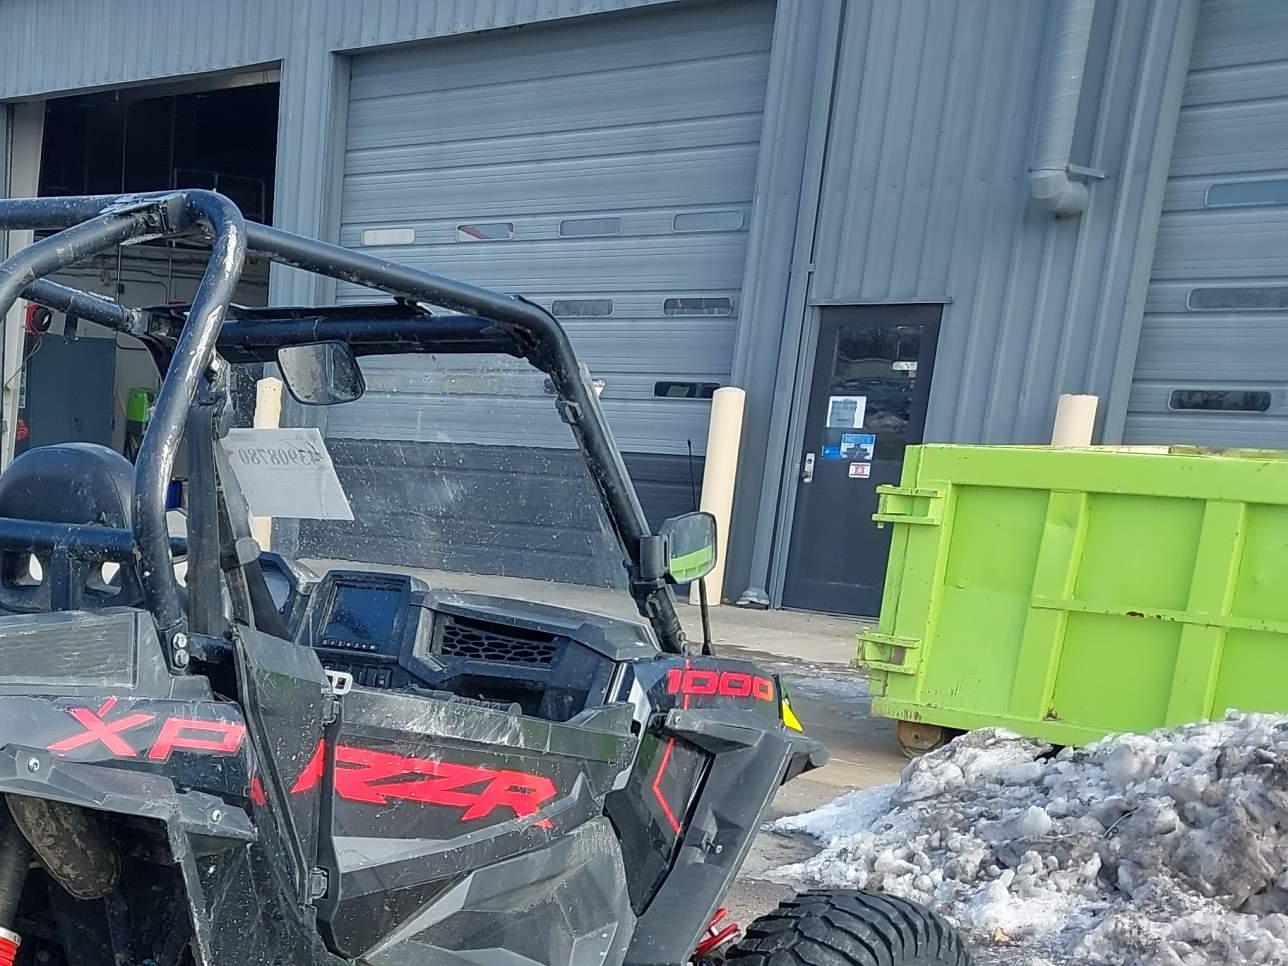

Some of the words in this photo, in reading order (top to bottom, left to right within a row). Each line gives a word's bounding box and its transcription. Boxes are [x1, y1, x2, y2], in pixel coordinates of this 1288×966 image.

[667, 668, 774, 702] 1000
[46, 695, 247, 761] XP
[290, 738, 557, 828] RZR
